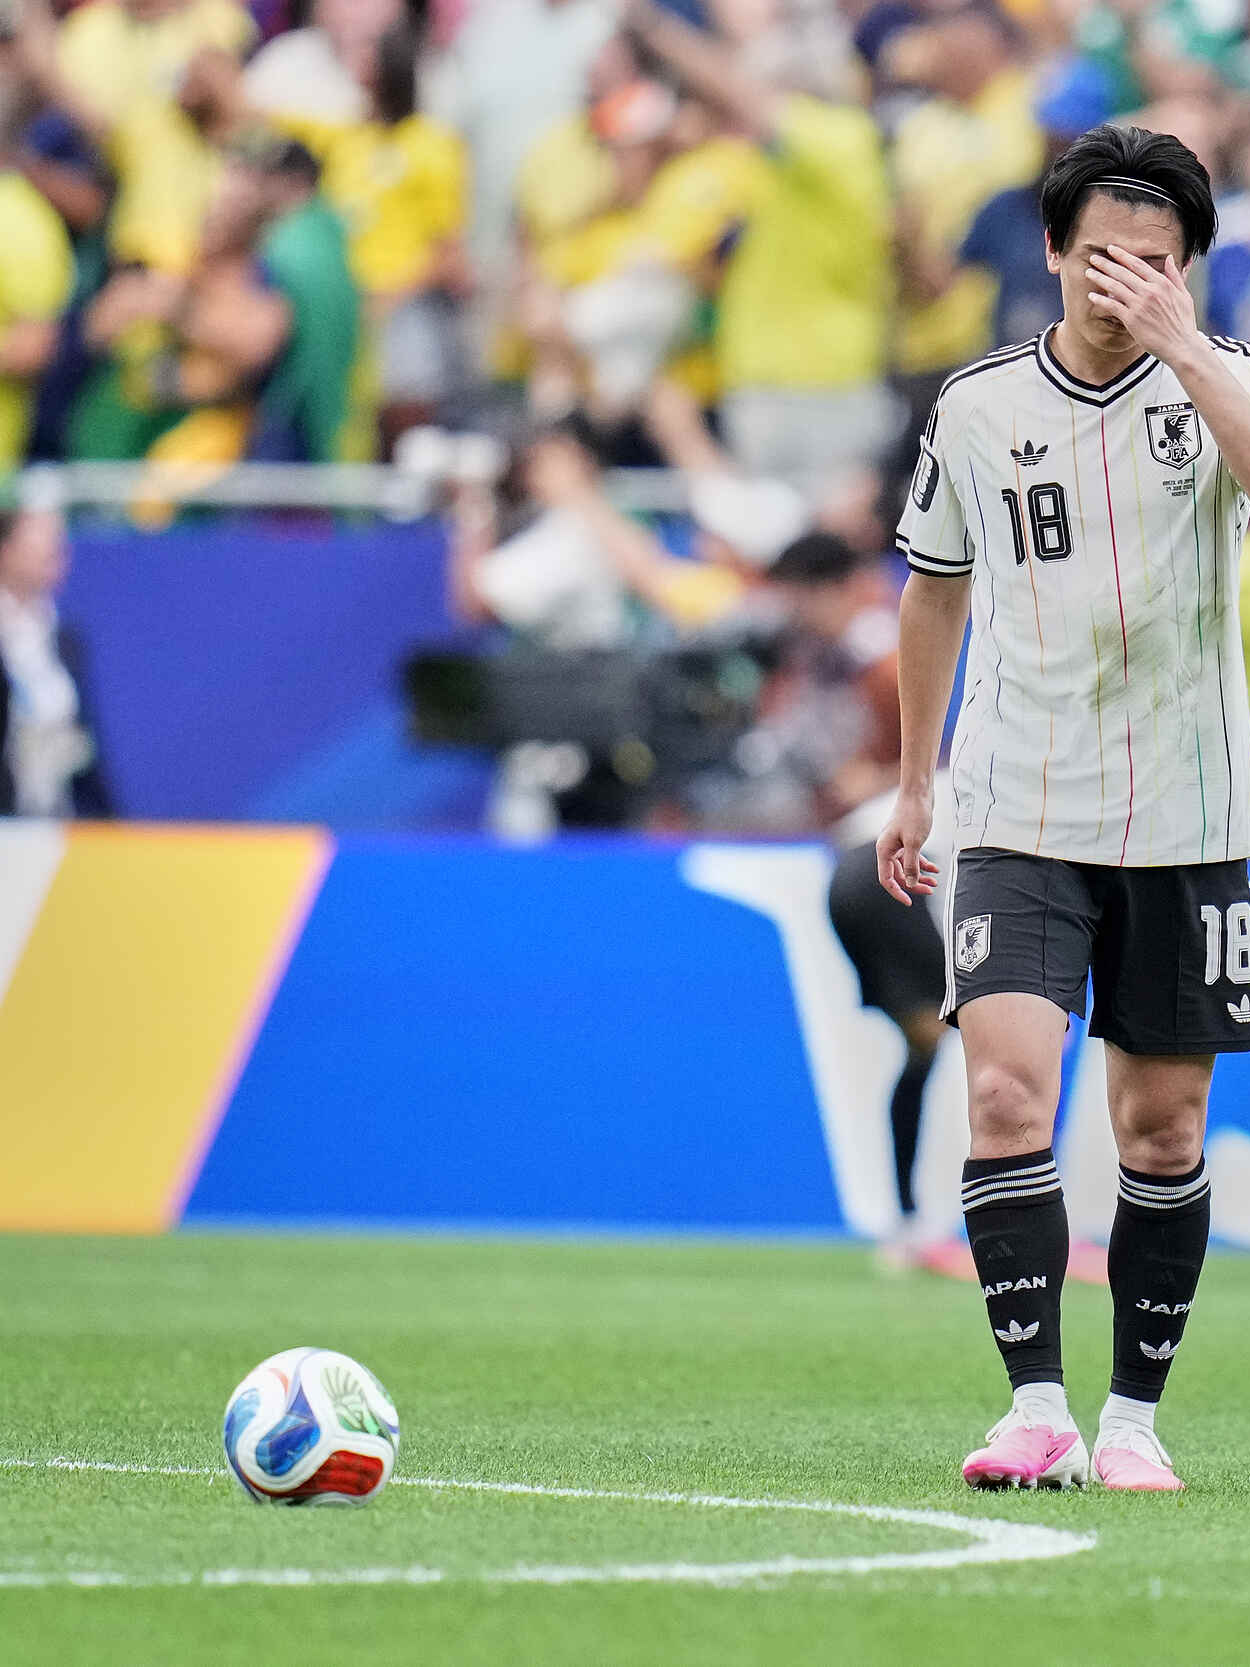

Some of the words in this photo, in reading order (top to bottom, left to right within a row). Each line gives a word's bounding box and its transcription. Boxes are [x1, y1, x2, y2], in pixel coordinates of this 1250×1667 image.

[1157, 403, 1185, 413] JAPAN
[1165, 447, 1189, 460] JFA
[1001, 482, 1074, 567] 18
[982, 1276, 1047, 1299] APAN
